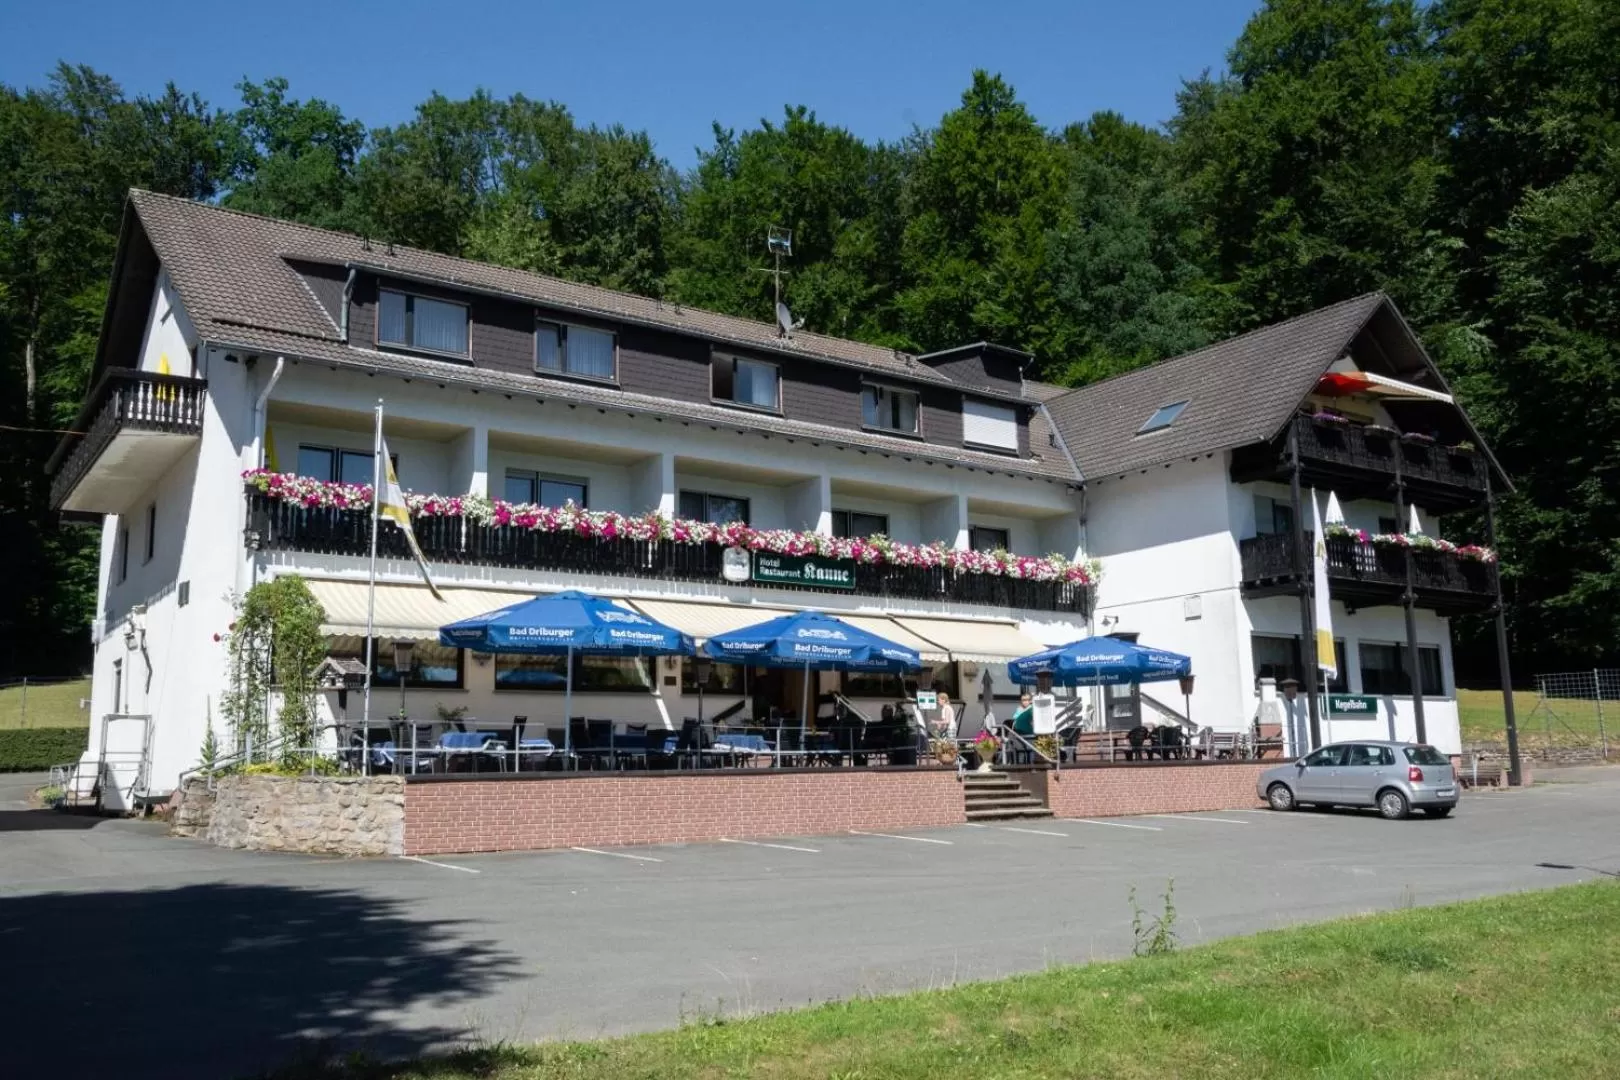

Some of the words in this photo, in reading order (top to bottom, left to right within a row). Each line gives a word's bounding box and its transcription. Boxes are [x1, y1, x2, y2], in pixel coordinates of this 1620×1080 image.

[760, 557, 780, 568] Hotel
[760, 566, 801, 578] Restaurant
[509, 627, 527, 636] Bad
[529, 627, 575, 638] Driburger
[610, 629, 626, 637] Bad
[795, 643, 811, 652] Bad
[812, 645, 852, 656] Driburger
[1335, 699, 1368, 712] Kegelbahn
